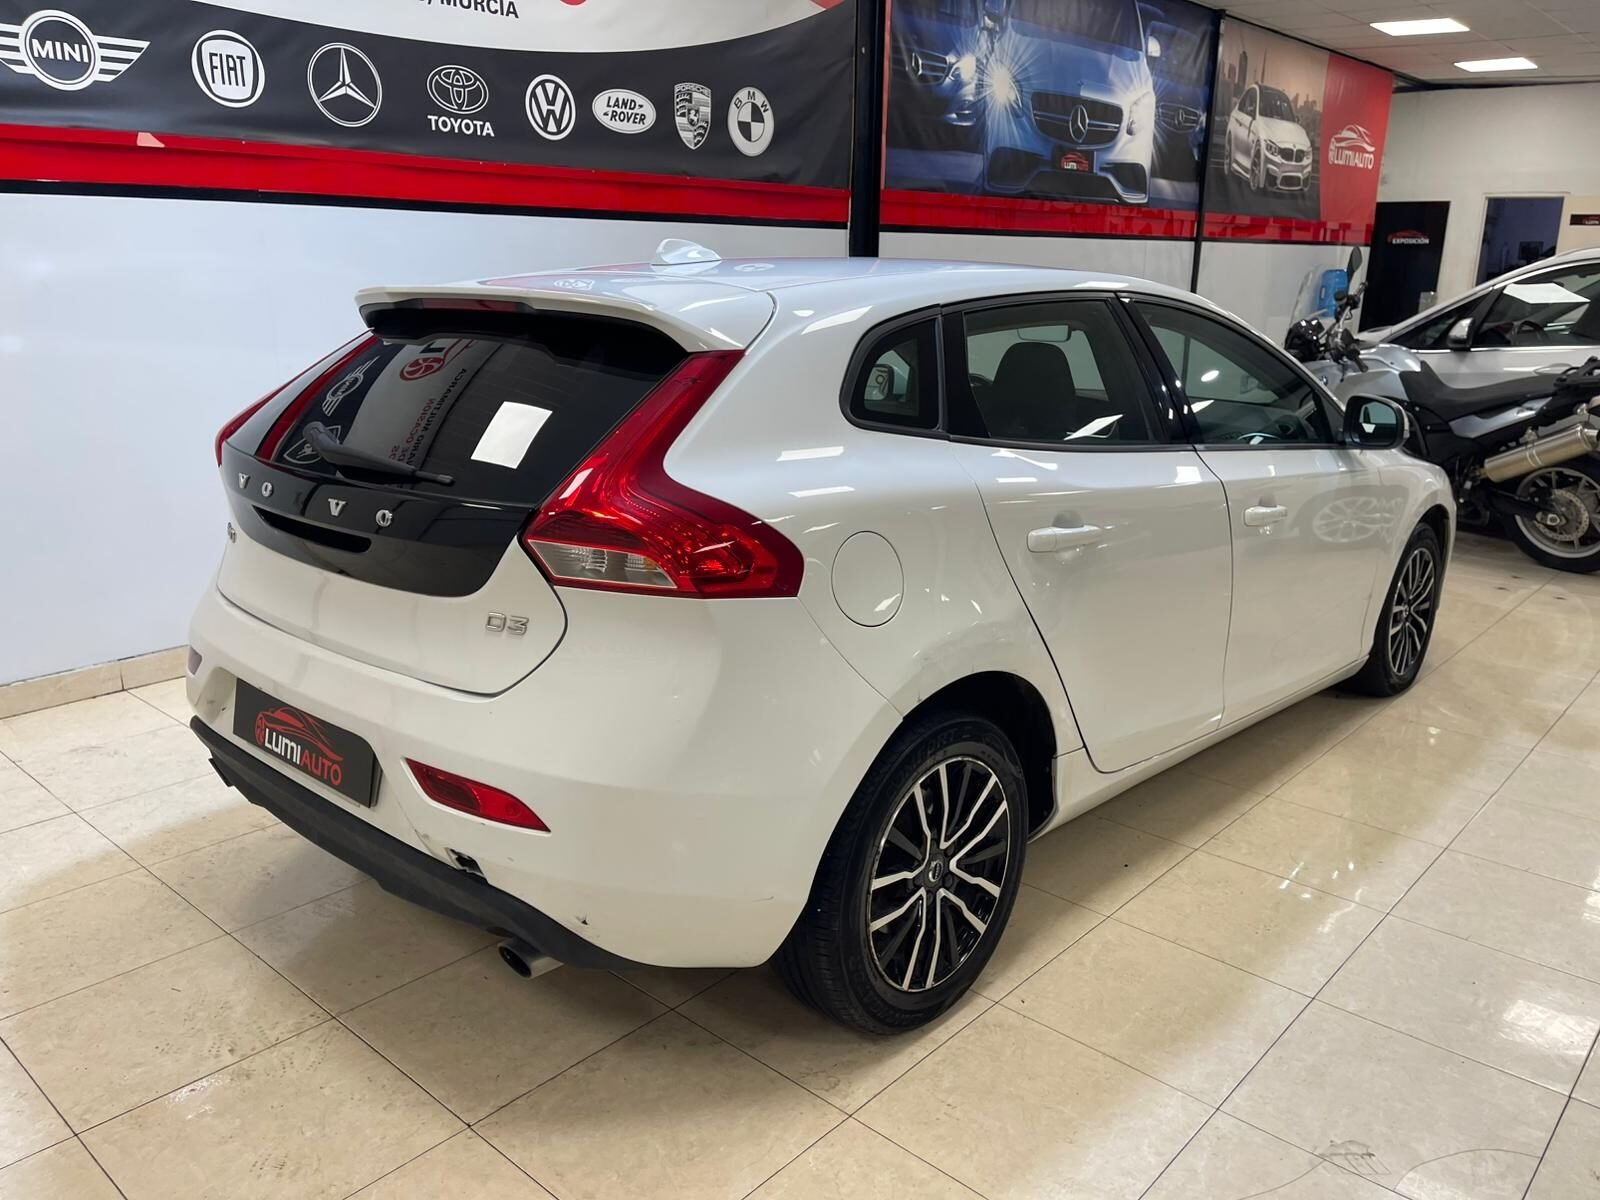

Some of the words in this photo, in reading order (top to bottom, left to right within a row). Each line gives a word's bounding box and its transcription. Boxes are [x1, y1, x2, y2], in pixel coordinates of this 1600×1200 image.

[31, 38, 90, 63] MINI
[208, 52, 246, 87] FIAT
[734, 90, 769, 114] BMW
[427, 115, 495, 137] TOYOTA
[610, 110, 647, 126] ROVER
[485, 611, 530, 636] D3
